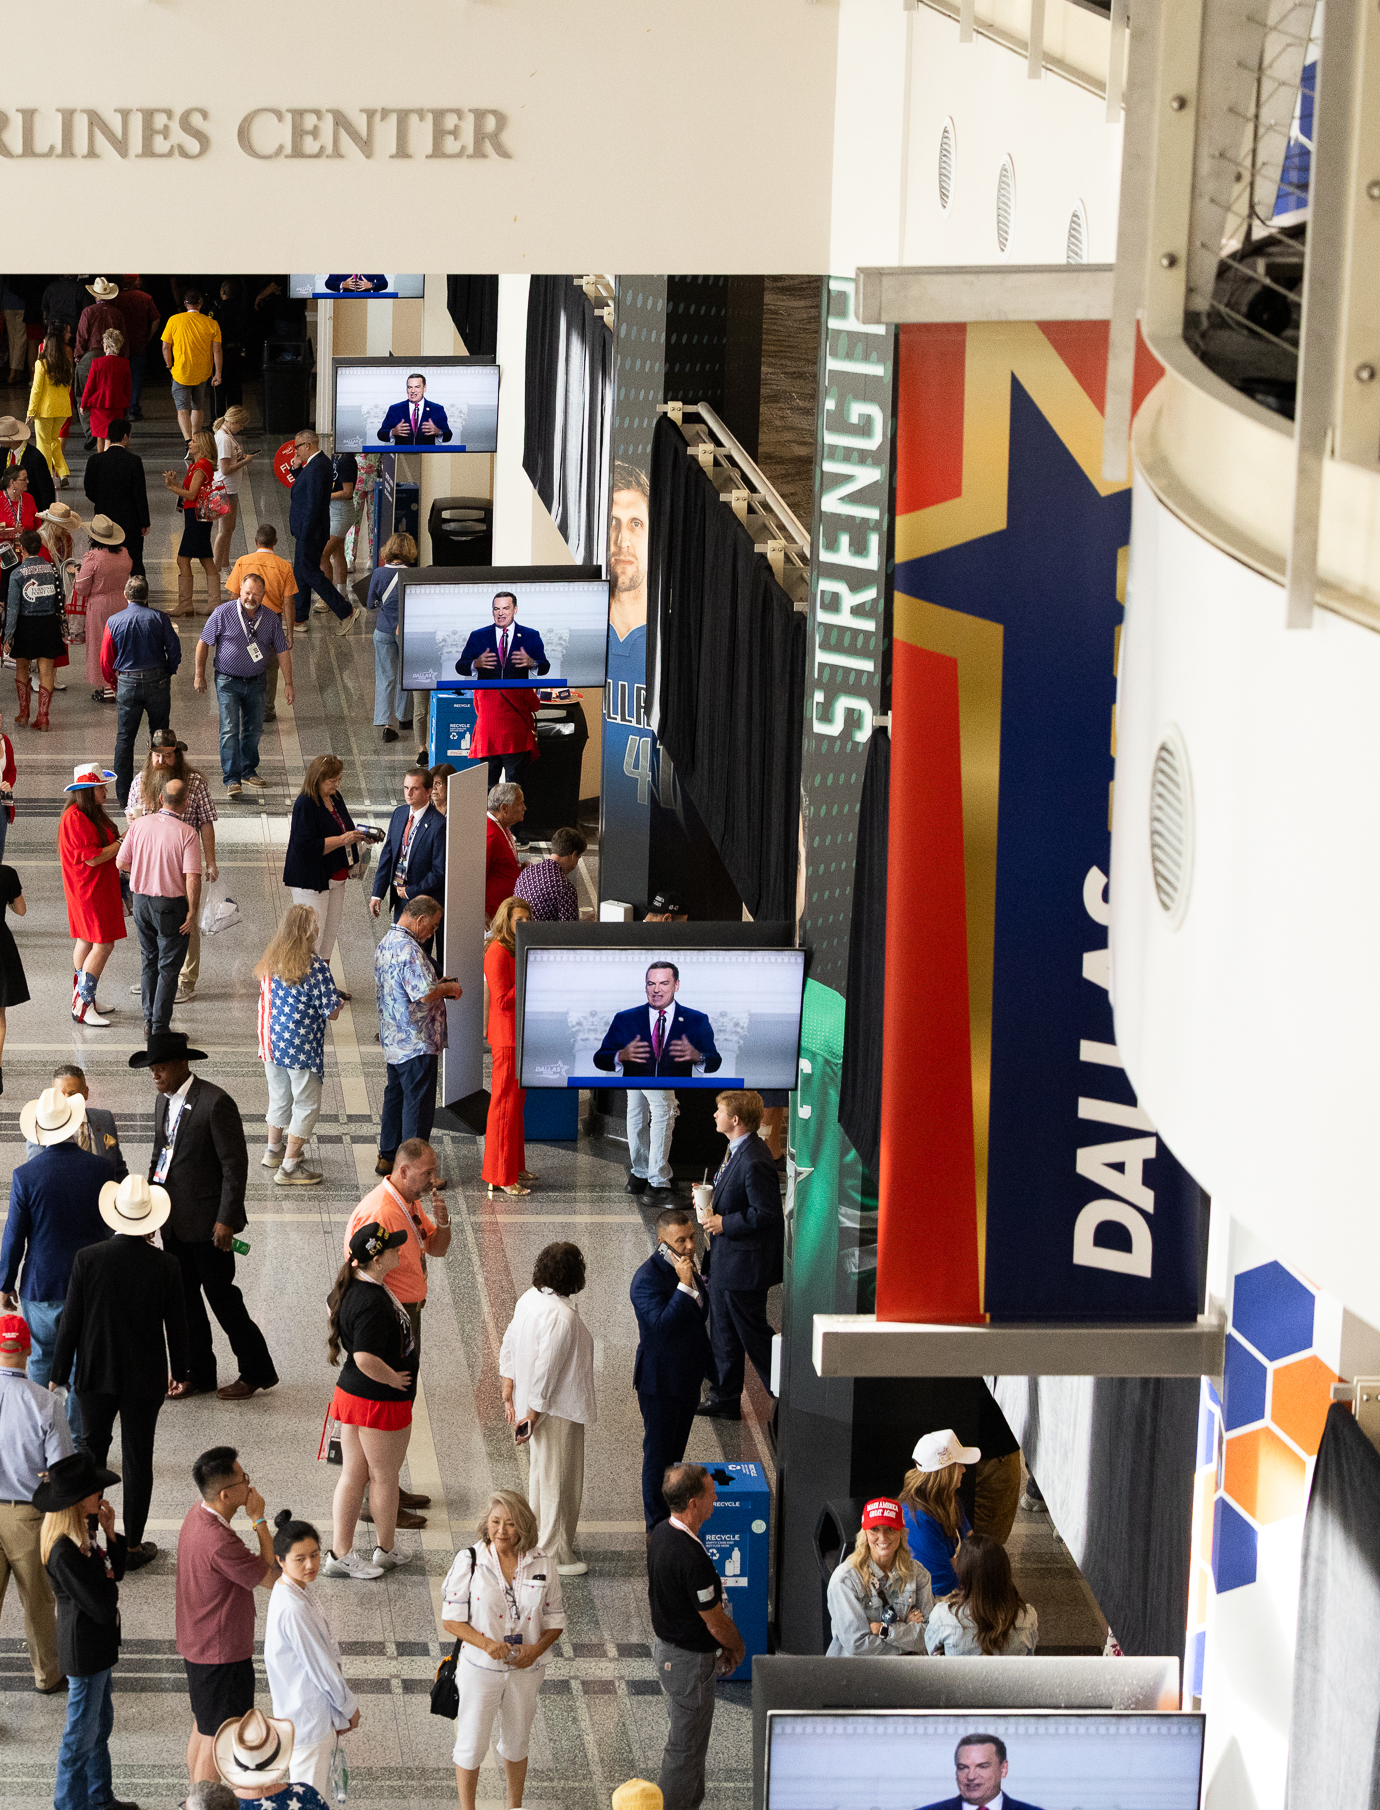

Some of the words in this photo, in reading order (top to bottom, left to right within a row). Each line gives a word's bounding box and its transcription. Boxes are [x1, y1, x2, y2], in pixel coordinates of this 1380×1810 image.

[237, 108, 514, 159] CENTER
[606, 679, 653, 729] LLA
[623, 735, 675, 808] 41
[866, 1502, 879, 1511] MAKE
[879, 1501, 899, 1512] AMERICA
[869, 1509, 883, 1518] GREAT
[883, 1509, 897, 1519] AGAIN
